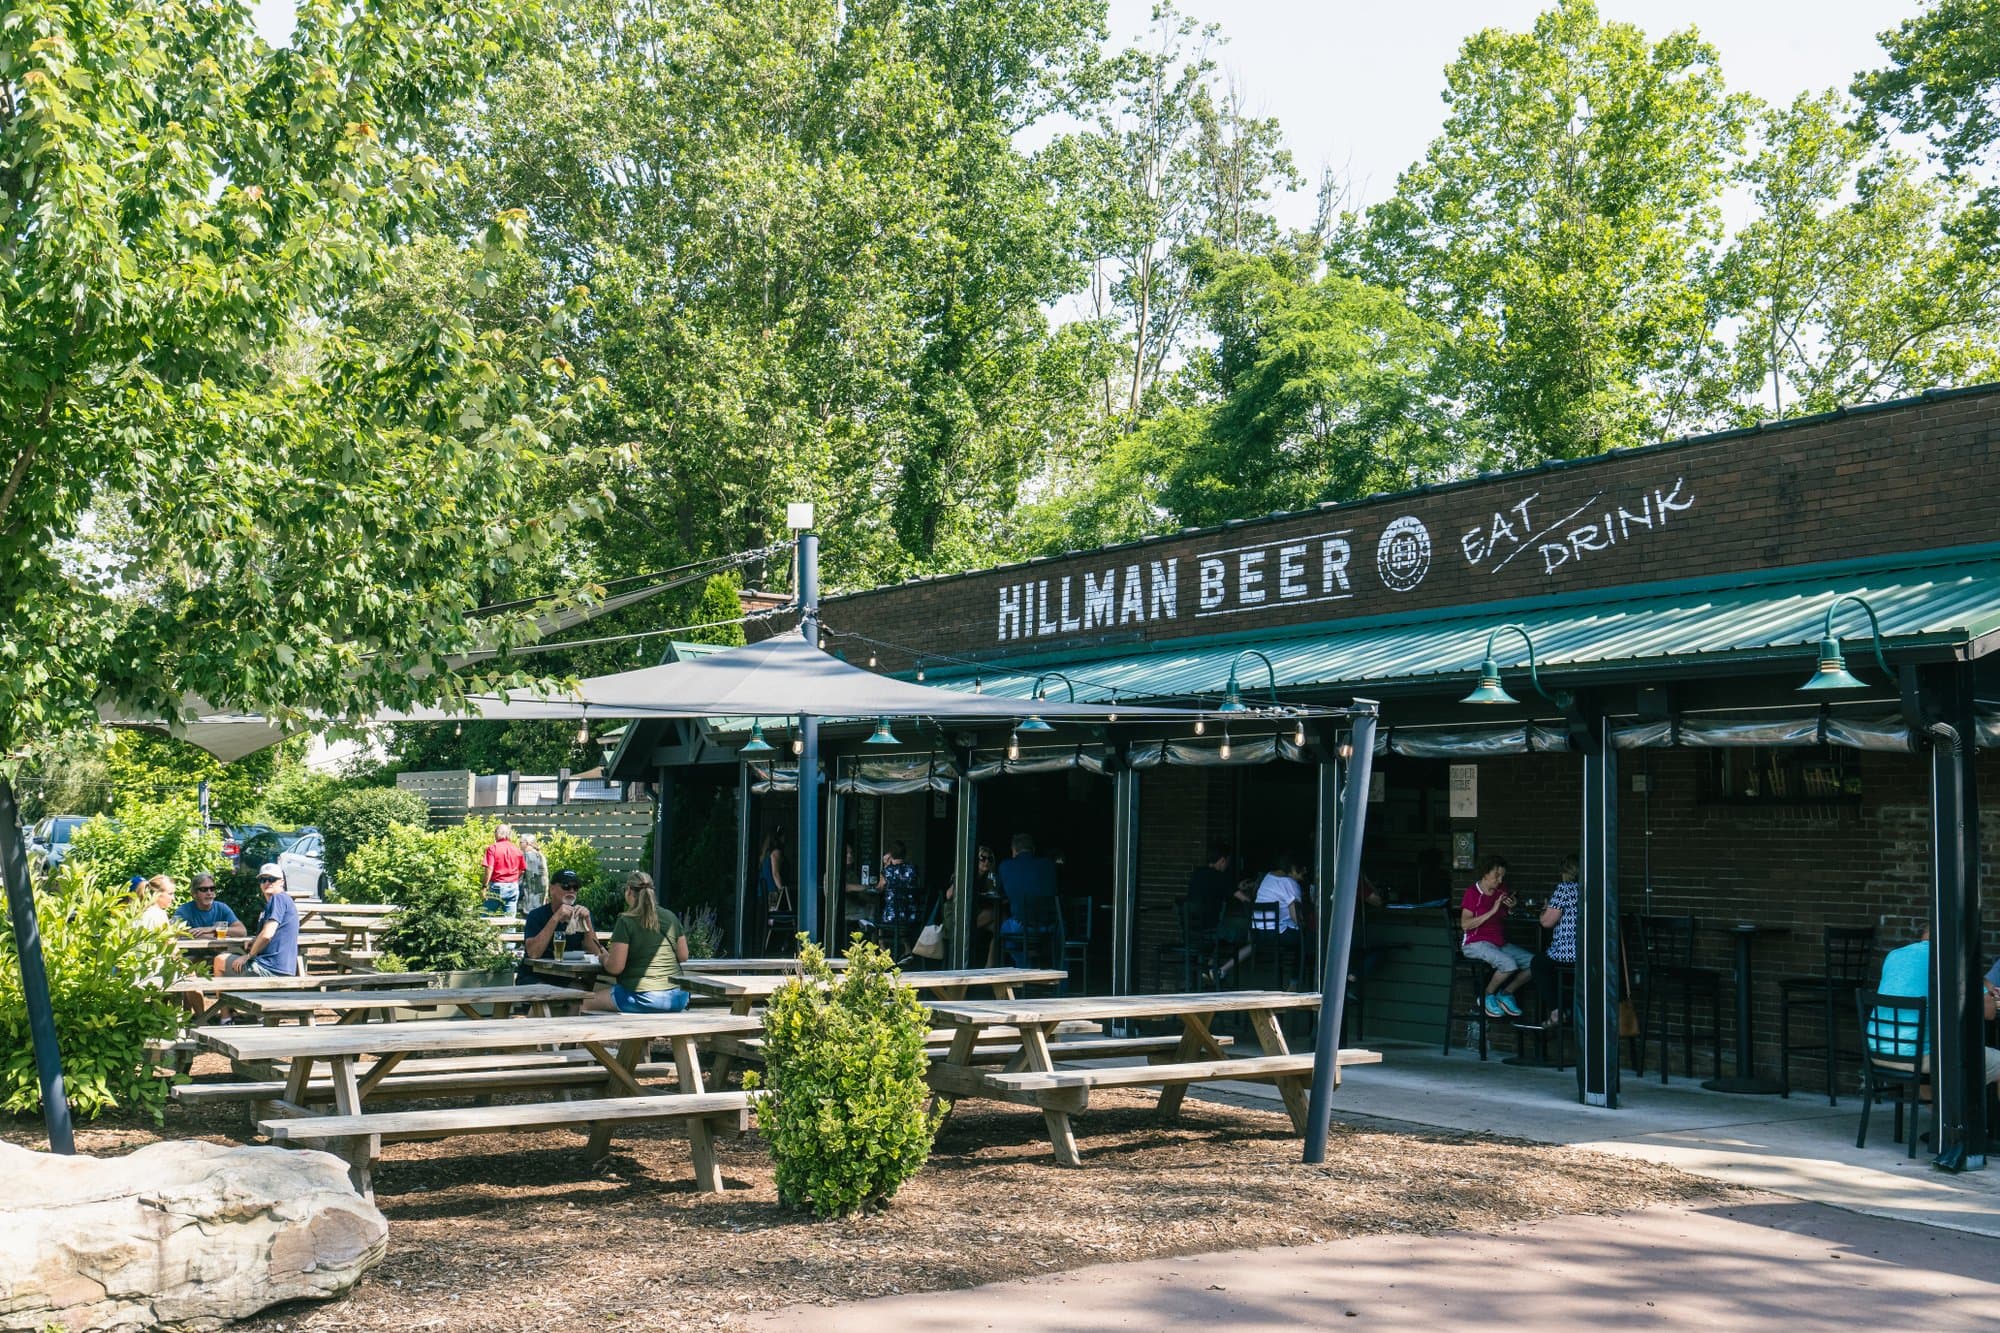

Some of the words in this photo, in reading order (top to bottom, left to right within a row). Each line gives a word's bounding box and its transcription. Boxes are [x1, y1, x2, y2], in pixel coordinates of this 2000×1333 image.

[1461, 492, 1540, 565] EAT
[1538, 477, 1695, 575] DRINK
[998, 557, 1178, 641] HILLMAN
[1200, 538, 1351, 609] BEER
